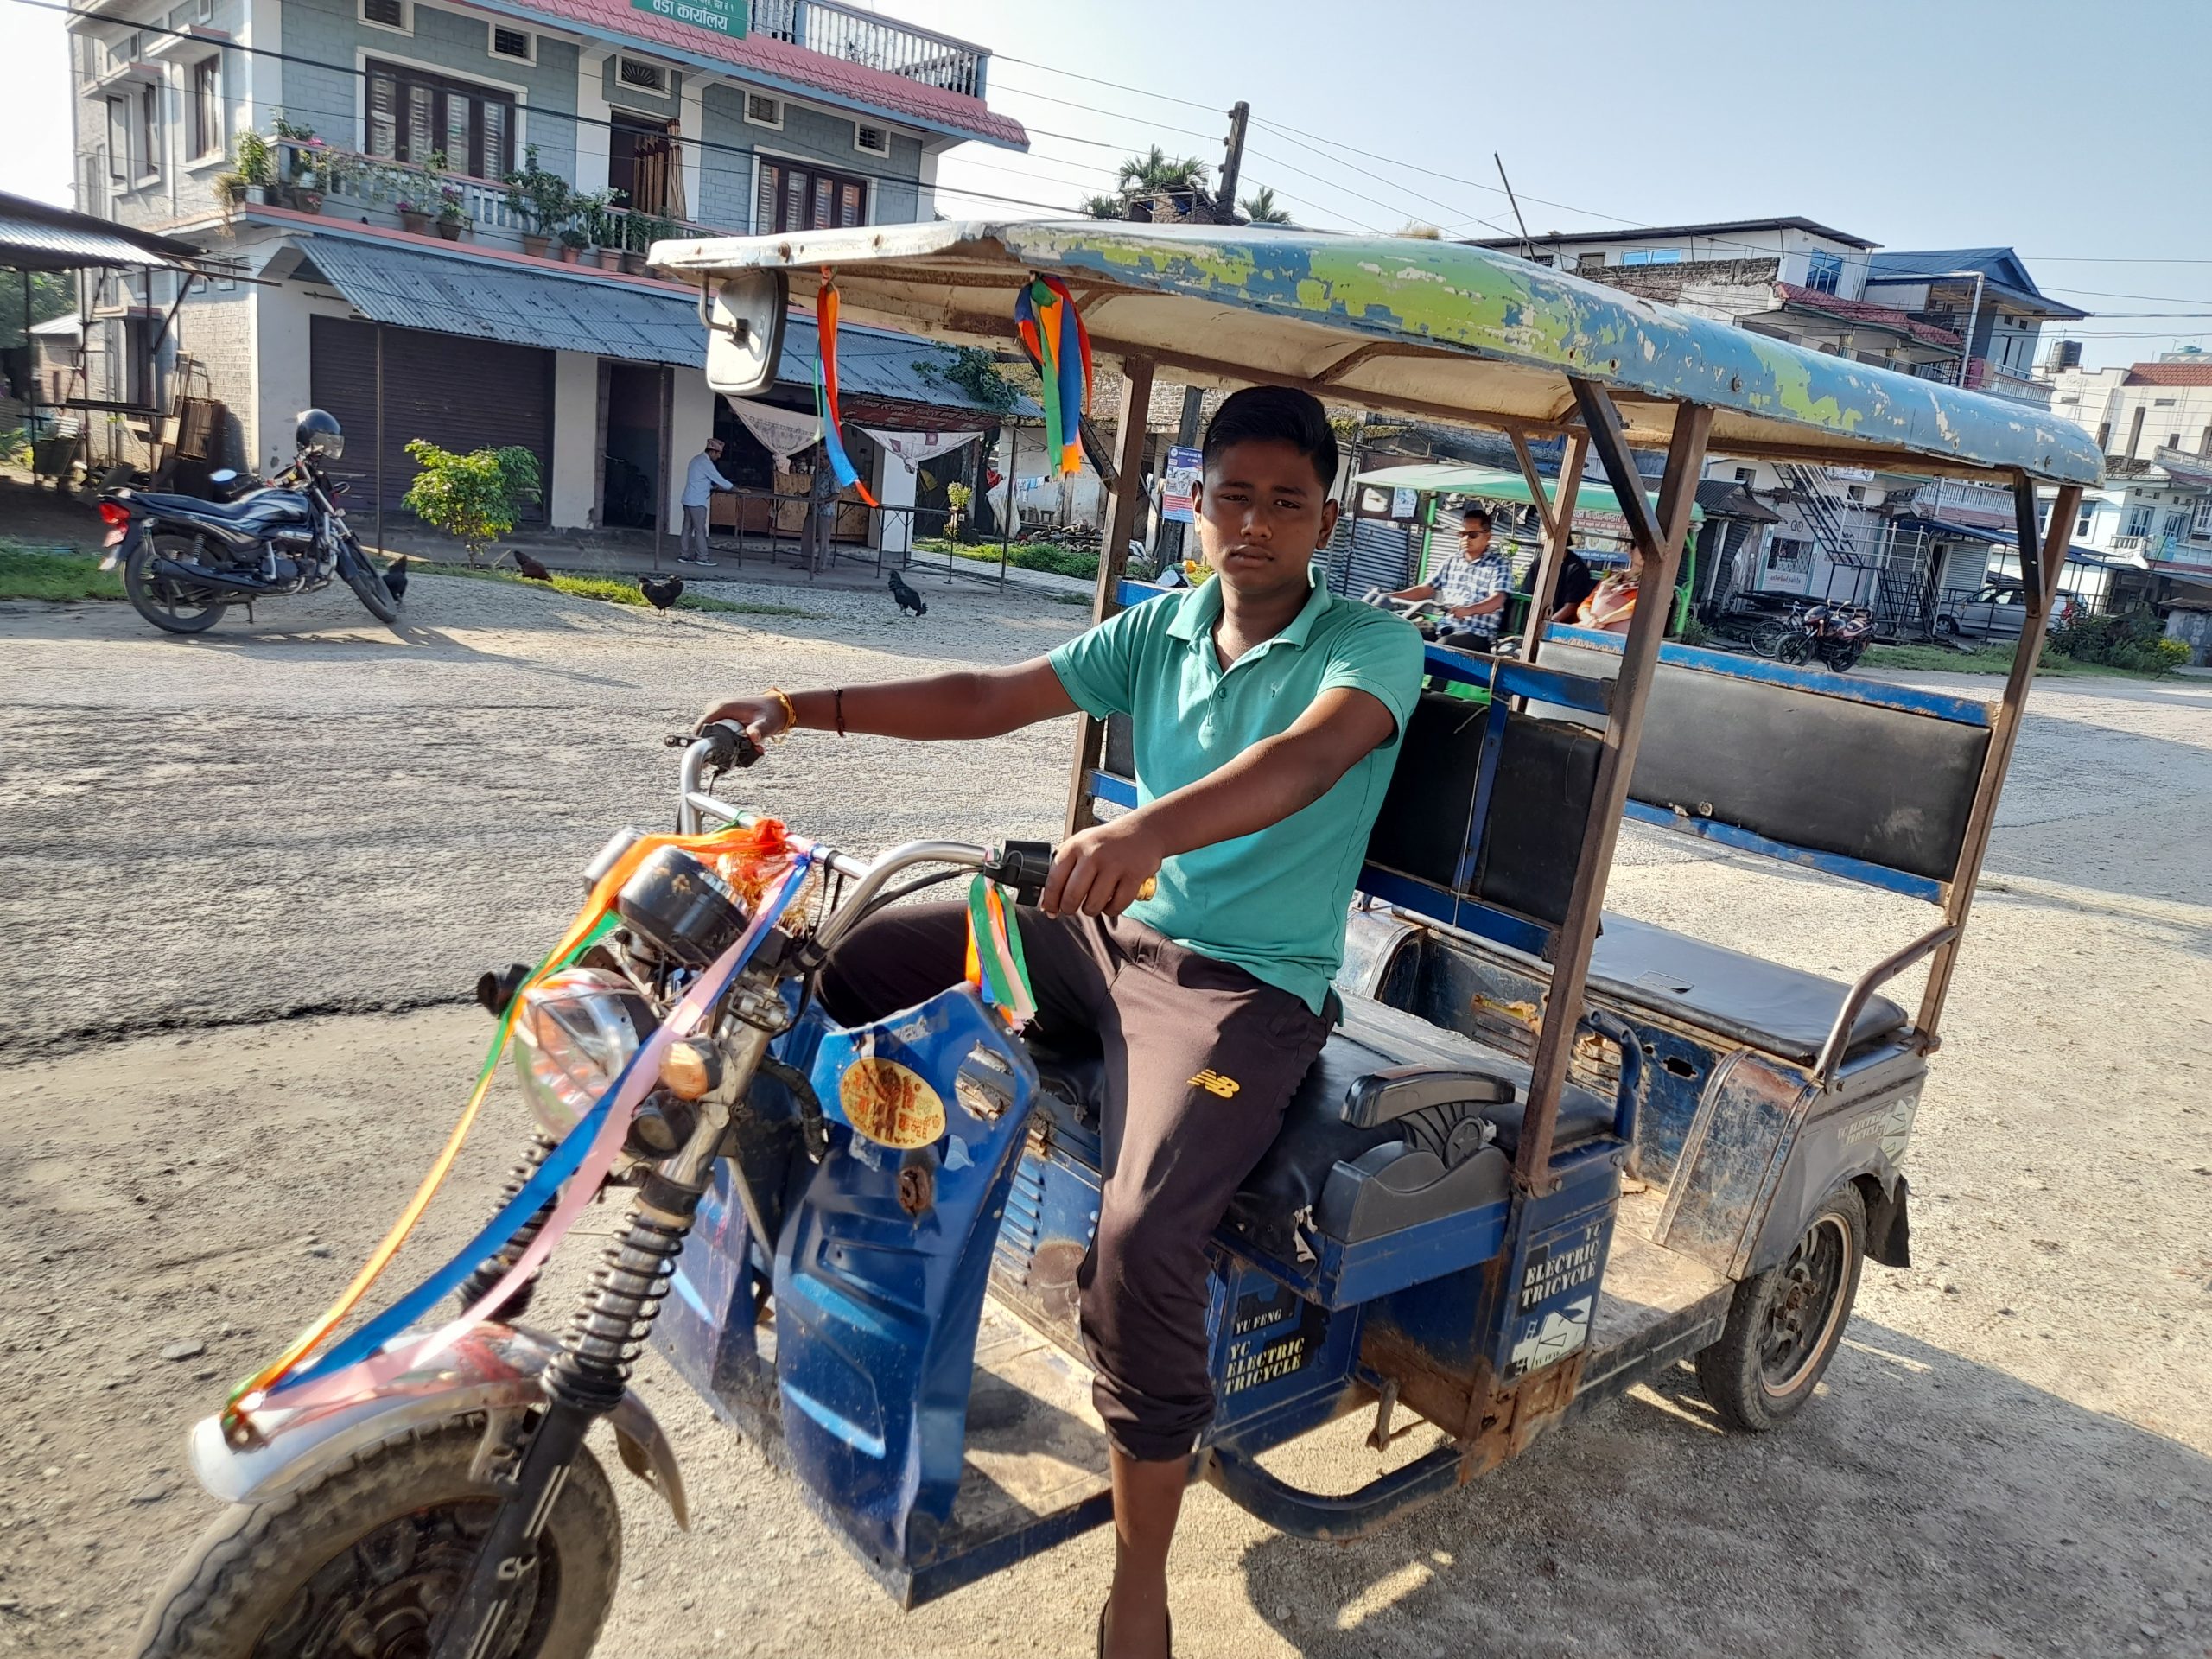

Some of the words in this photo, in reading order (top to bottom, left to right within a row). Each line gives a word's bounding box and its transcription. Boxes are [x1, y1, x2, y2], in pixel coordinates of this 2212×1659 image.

[677, 3, 728, 30] कार्यालय
[1585, 1223, 1605, 1242] YC
[1524, 1240, 1599, 1287] ELECTRIC
[1522, 1261, 1597, 1307] TRICYCLE
[1236, 1319, 1251, 1335] YU
[1253, 1308, 1282, 1329] FENG
[1227, 1338, 1305, 1378] ELECTRIC
[1230, 1340, 1251, 1360] YC
[1224, 1354, 1301, 1395] TRICYCLE
